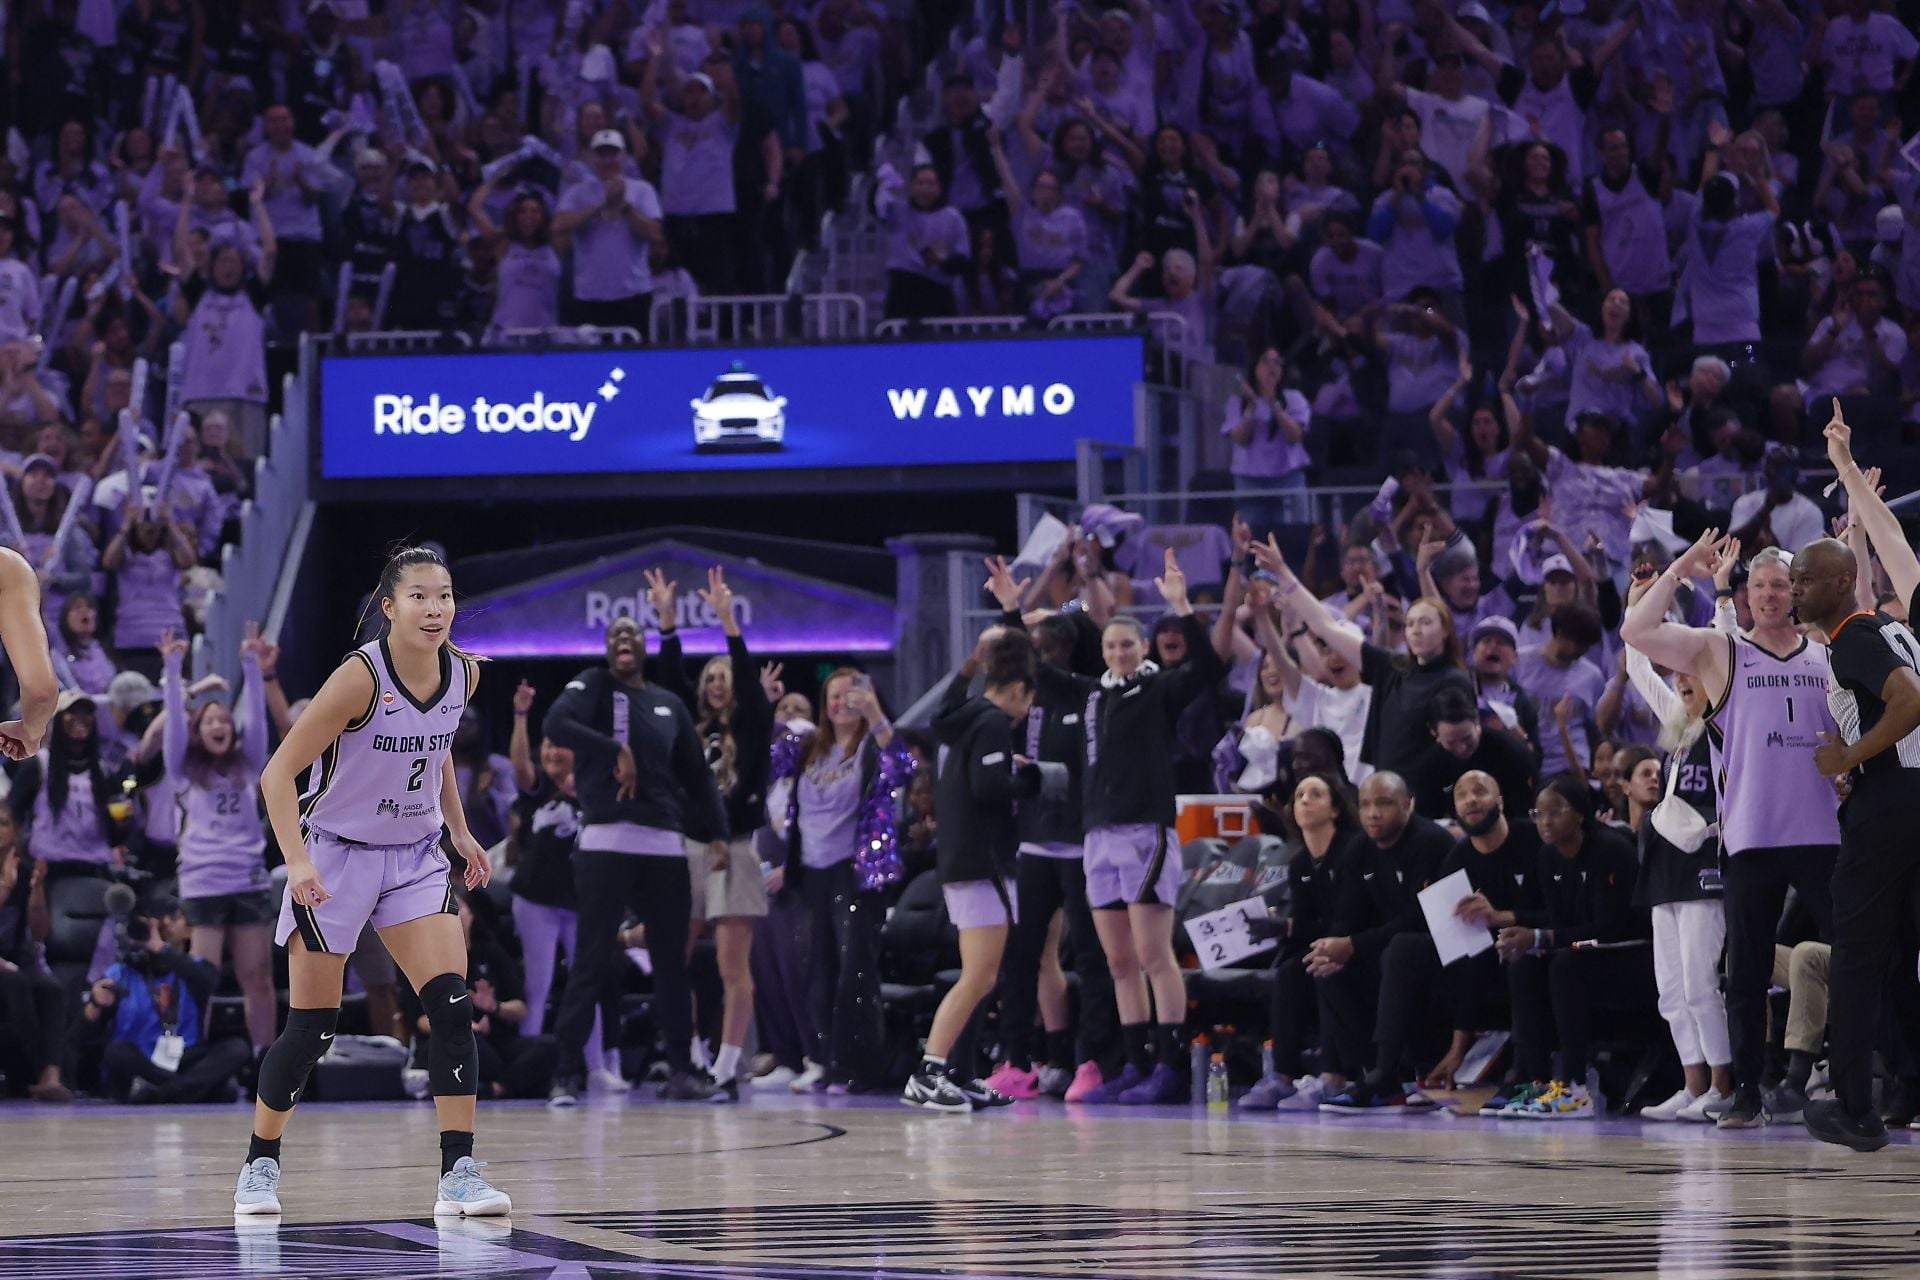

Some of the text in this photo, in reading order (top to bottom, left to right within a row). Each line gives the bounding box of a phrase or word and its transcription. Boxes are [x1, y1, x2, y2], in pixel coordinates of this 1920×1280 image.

[887, 383, 1075, 420] WAYMO
[374, 391, 597, 441] Ride today
[1747, 674, 1825, 689] GOLDEN STATE
[1786, 697, 1794, 722] 1
[372, 734, 425, 753] GOLDEN
[405, 756, 429, 793] 2
[1680, 764, 1709, 792] 25
[216, 792, 241, 815] 22
